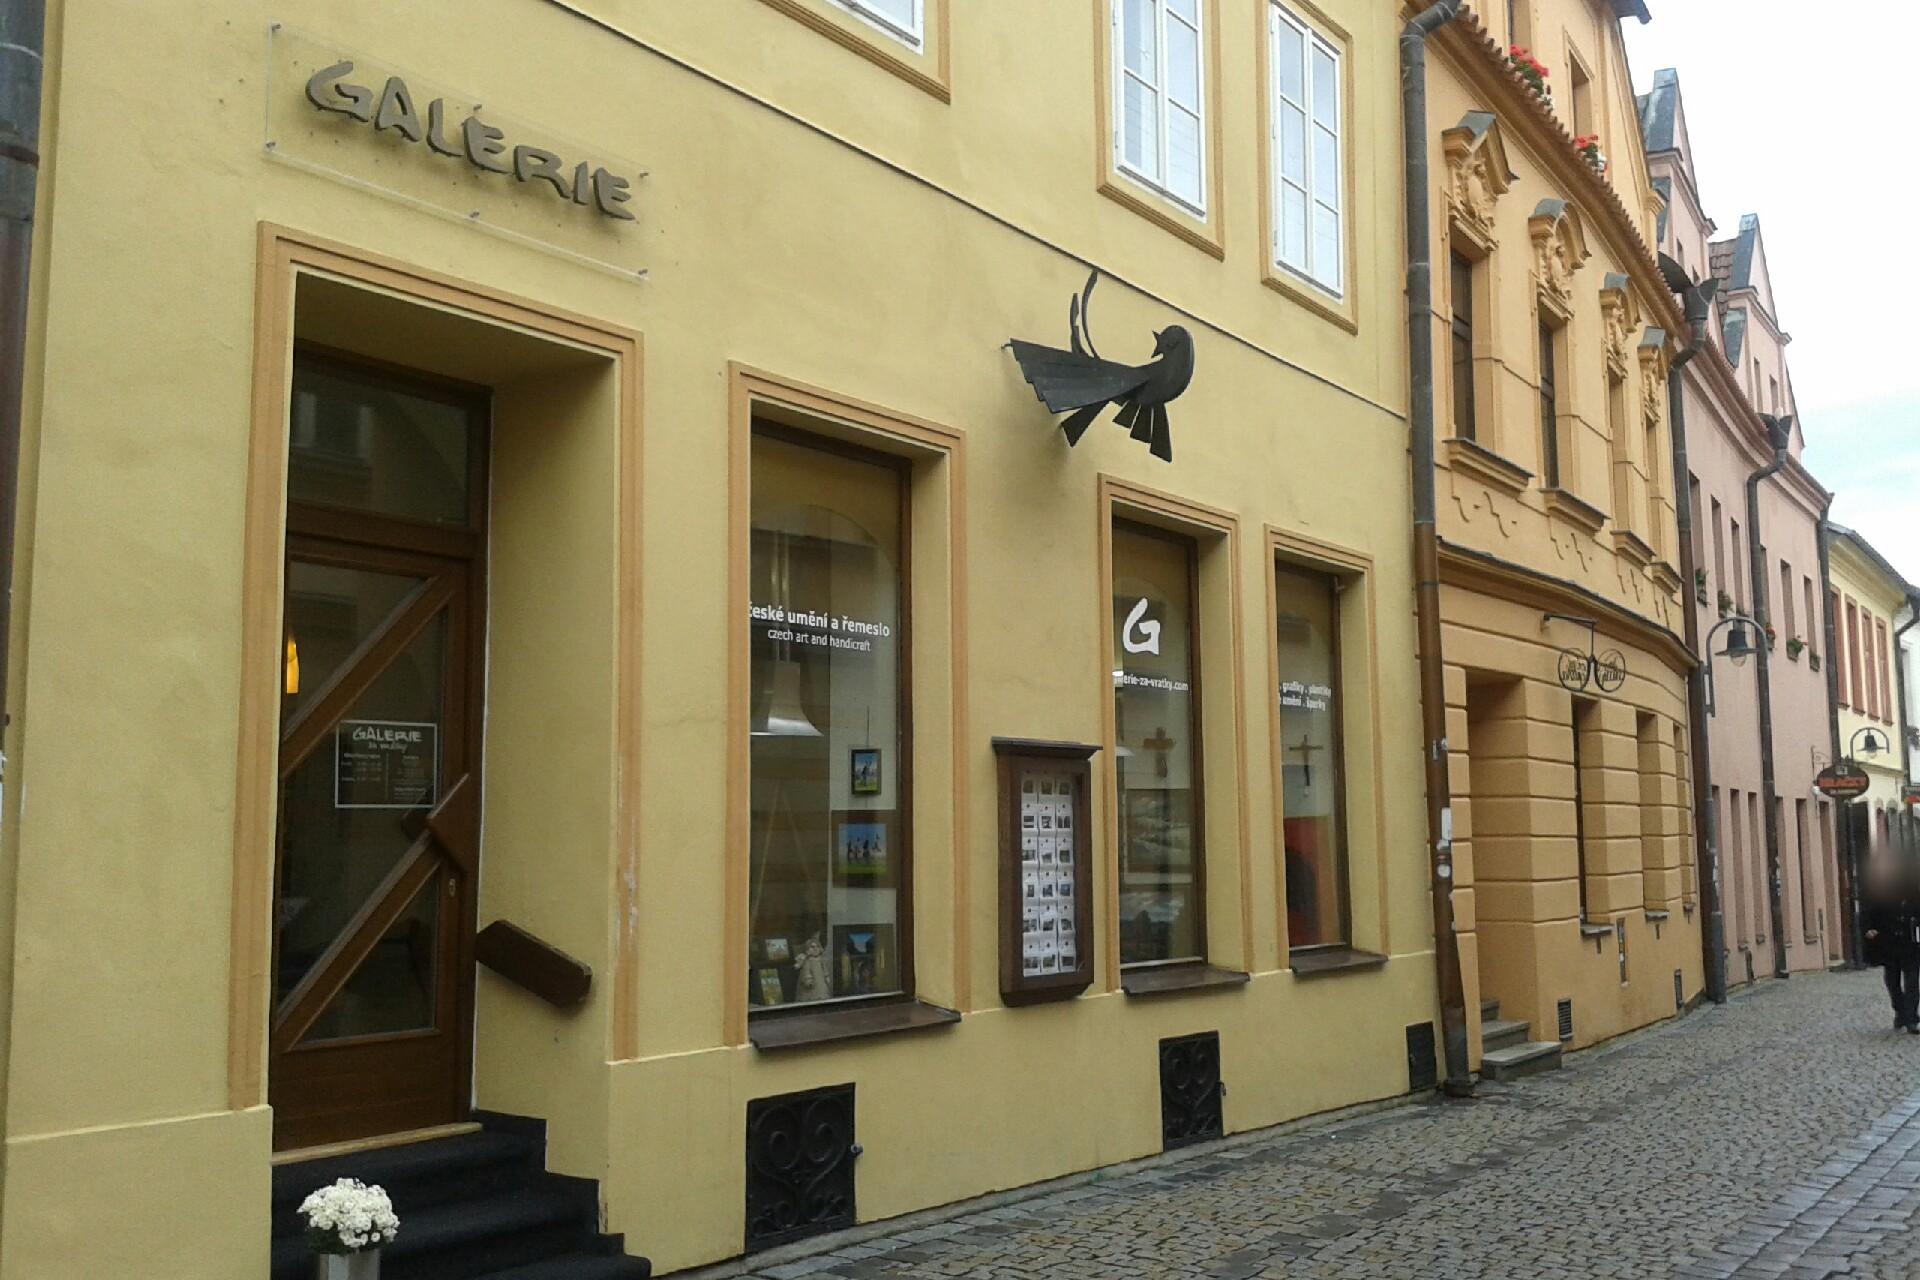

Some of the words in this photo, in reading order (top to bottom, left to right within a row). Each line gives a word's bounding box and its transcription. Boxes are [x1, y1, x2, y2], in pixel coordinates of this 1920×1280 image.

[305, 61, 636, 221] GALERIE
[788, 610, 828, 628] umění
[831, 618, 839, 630] a
[842, 615, 891, 637] řemeslo
[1123, 598, 1161, 655] G
[767, 629, 793, 641] czech
[796, 632, 809, 643] art
[811, 634, 828, 646] and
[830, 635, 872, 652] handicraft
[352, 726, 423, 742] GALERIE
